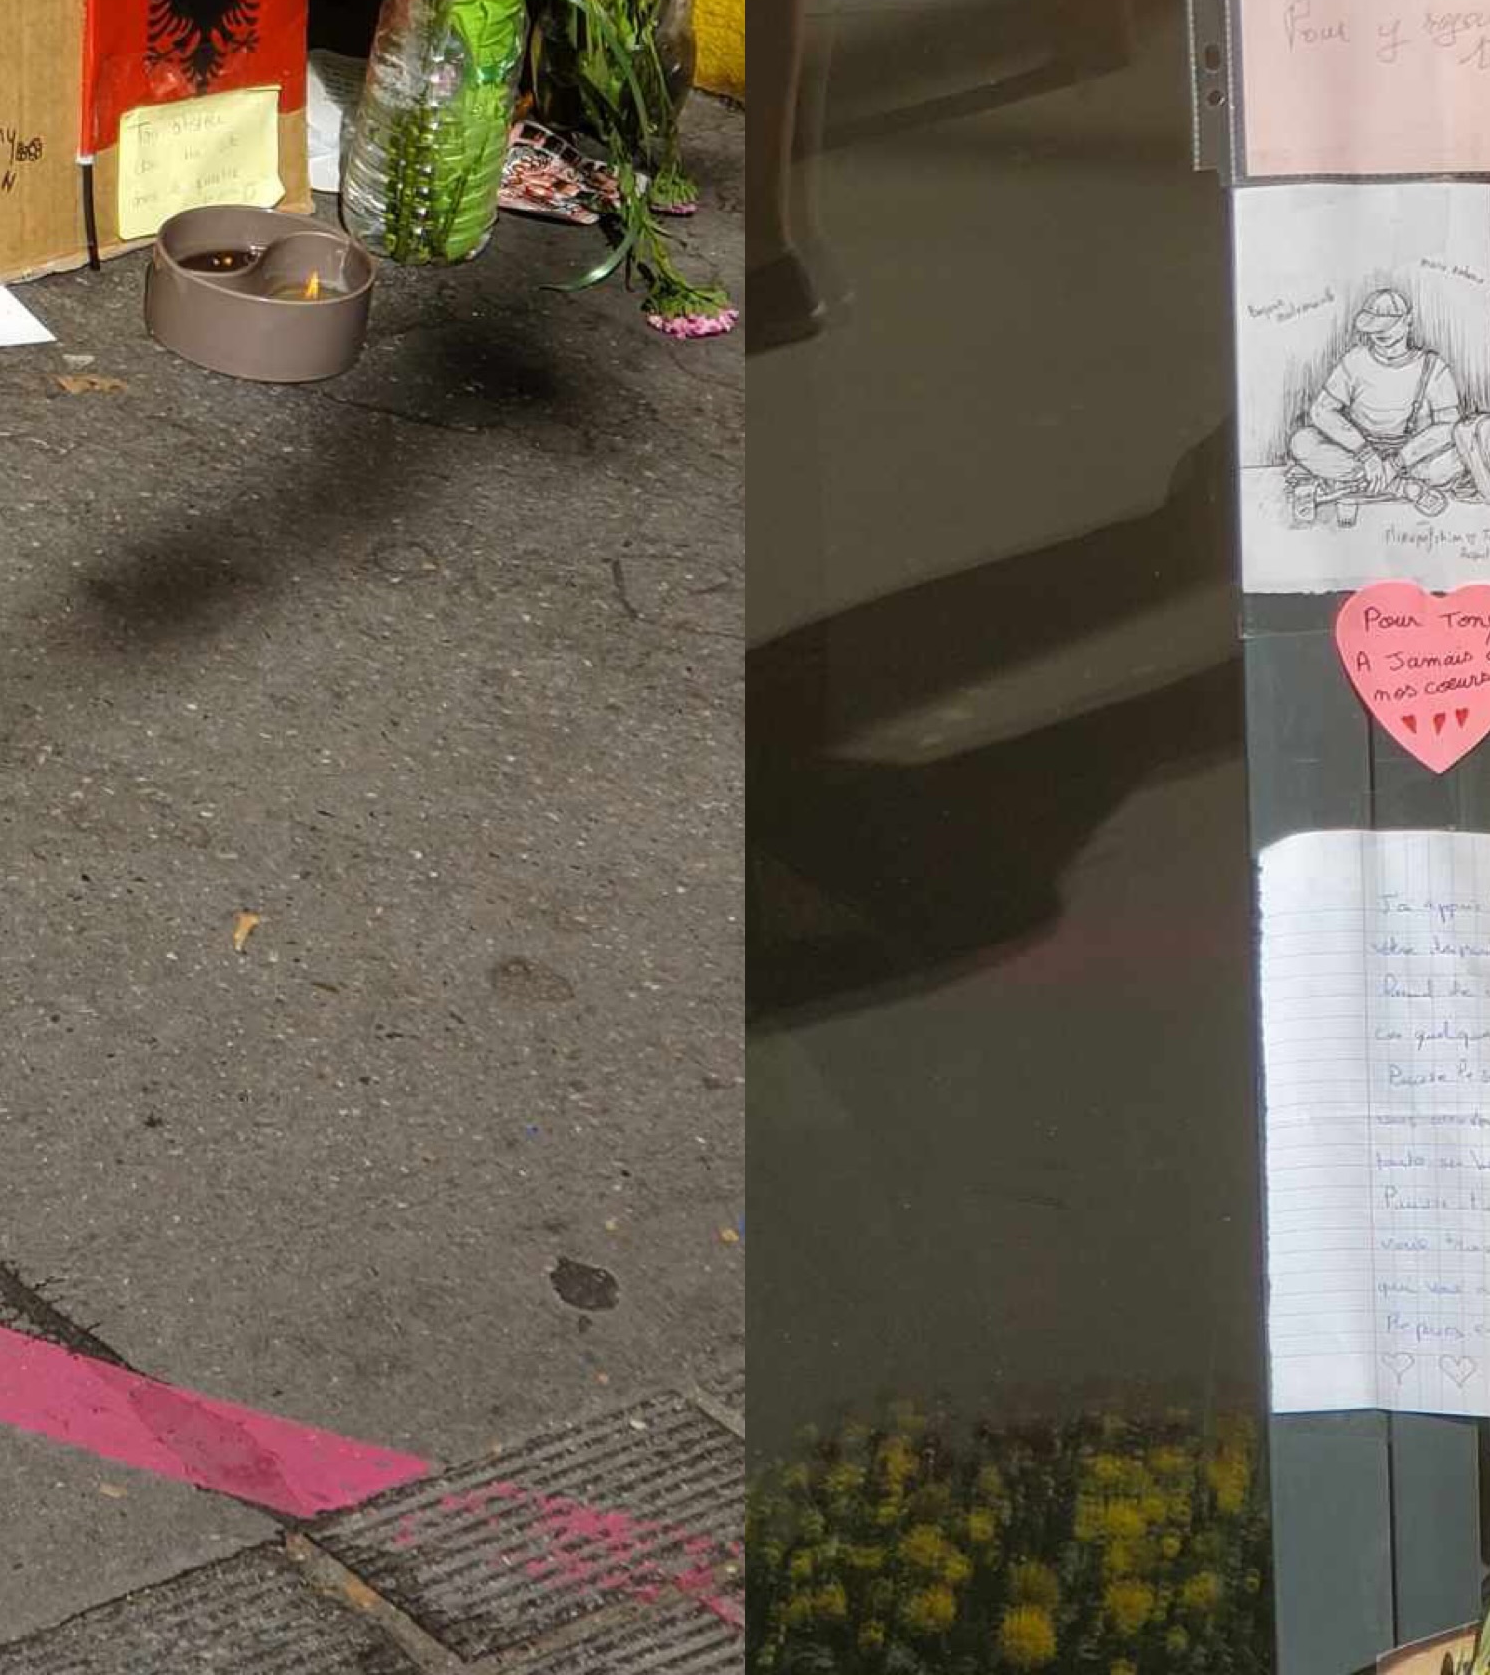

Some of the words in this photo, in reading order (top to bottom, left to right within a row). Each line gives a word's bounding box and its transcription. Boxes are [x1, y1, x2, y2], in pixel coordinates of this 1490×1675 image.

[1363, 606, 1423, 632] Pour
[1356, 650, 1371, 672] A
[1385, 650, 1474, 672] Jamais
[1374, 685, 1418, 702] nos
